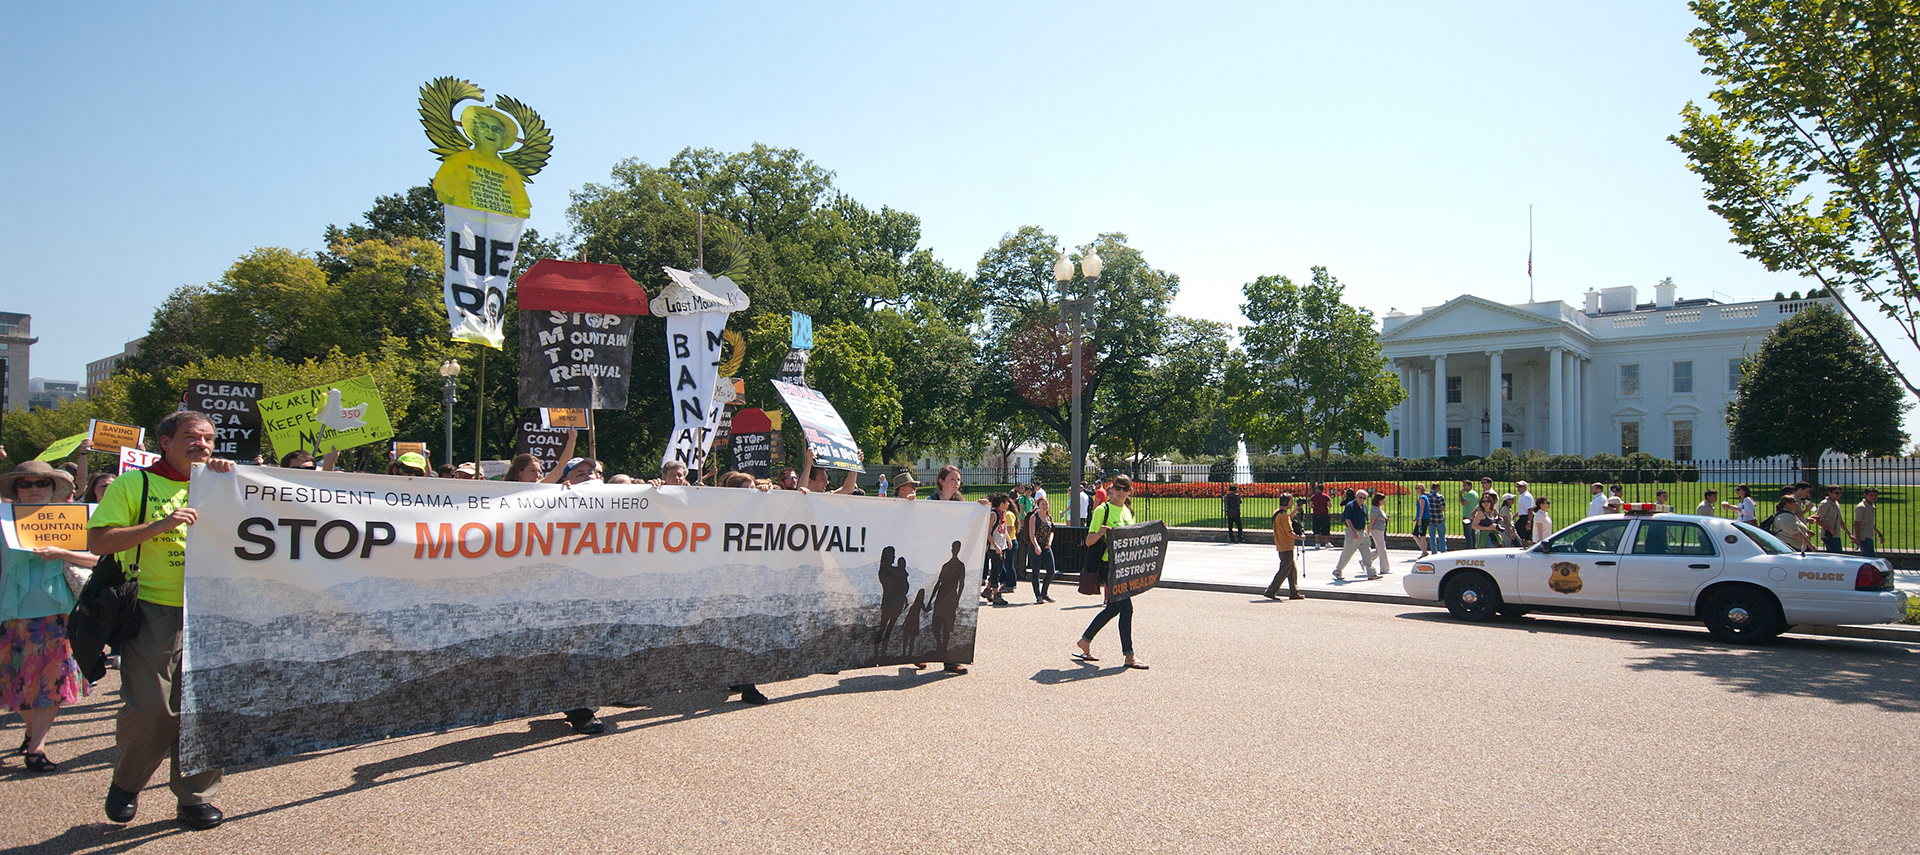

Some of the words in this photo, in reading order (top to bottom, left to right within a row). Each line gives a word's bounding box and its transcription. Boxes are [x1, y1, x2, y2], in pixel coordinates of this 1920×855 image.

[548, 310, 621, 329] STOP
[196, 384, 256, 398] CLEAN
[202, 398, 250, 412] COAL
[259, 400, 282, 412] WE
[286, 394, 308, 409] ARE
[228, 414, 241, 425] A
[341, 408, 360, 419] 350
[102, 425, 133, 436] SAVING
[216, 428, 254, 440] RTY
[527, 434, 562, 446] COAL
[736, 434, 764, 444] STOP
[530, 447, 543, 457] IS
[546, 448, 556, 457] A
[244, 485, 375, 505] PRESIDENT
[384, 492, 460, 511] OBAMA,
[468, 496, 491, 510] BE
[499, 496, 511, 510] A
[517, 496, 604, 510] MOUNTAIN
[610, 496, 649, 510] HERO
[233, 516, 396, 562] STOP
[413, 521, 712, 560] MOUNTAINTOP
[722, 522, 867, 553] REMOVAL!
[1112, 532, 1162, 550] DESTROYING
[1114, 546, 1160, 564] MOUNTAINS
[1456, 558, 1486, 567] POLICE
[1116, 561, 1156, 579] DESTROYS
[1798, 571, 1844, 582] POLICE
[1112, 582, 1128, 596] OUR
[1129, 574, 1158, 590] HEALTH
